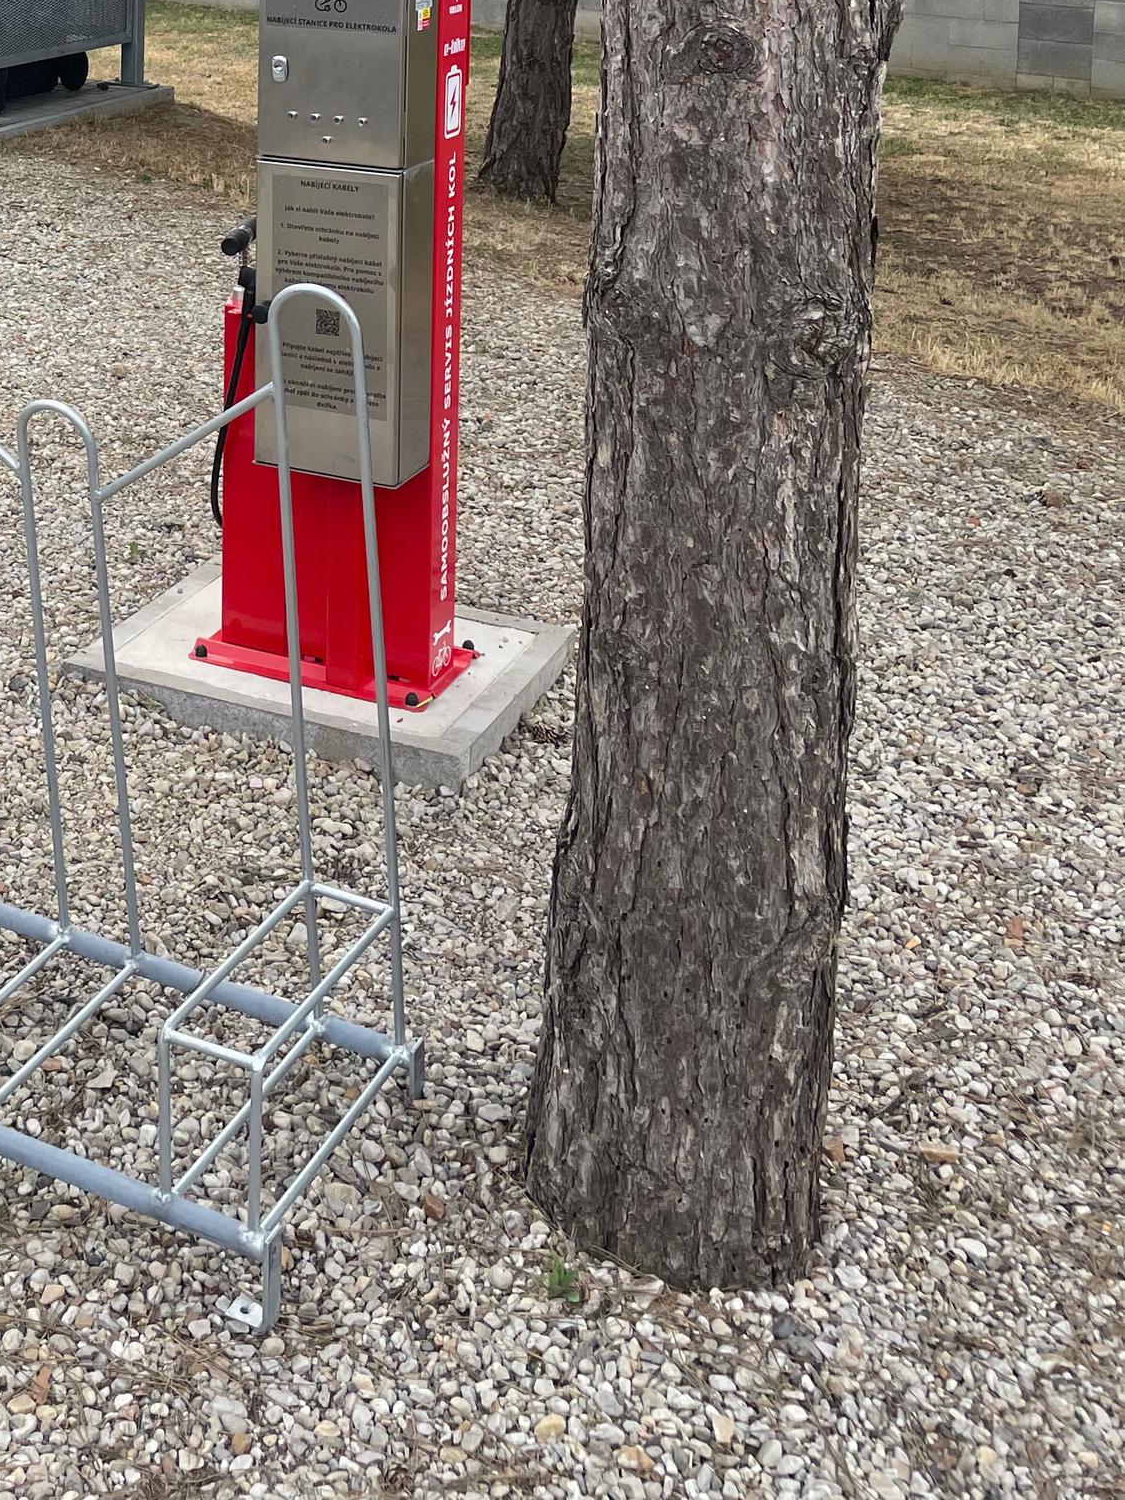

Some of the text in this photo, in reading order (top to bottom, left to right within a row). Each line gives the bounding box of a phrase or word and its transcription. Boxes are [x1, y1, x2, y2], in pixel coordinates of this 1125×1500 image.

[298, 18, 328, 28] STANICE
[345, 23, 397, 33] ELEKTROKOLA
[448, 151, 457, 198] KOL
[332, 183, 360, 192] KABELY
[336, 210, 375, 220] elektrokolo?
[287, 223, 314, 231] Otevřete
[318, 235, 340, 244] kabely
[284, 250, 308, 258] Vyberte
[364, 259, 382, 267] kabel
[443, 324, 452, 410] SERVIS
[440, 417, 451, 601] SAMOOBSLUŽNÝ
